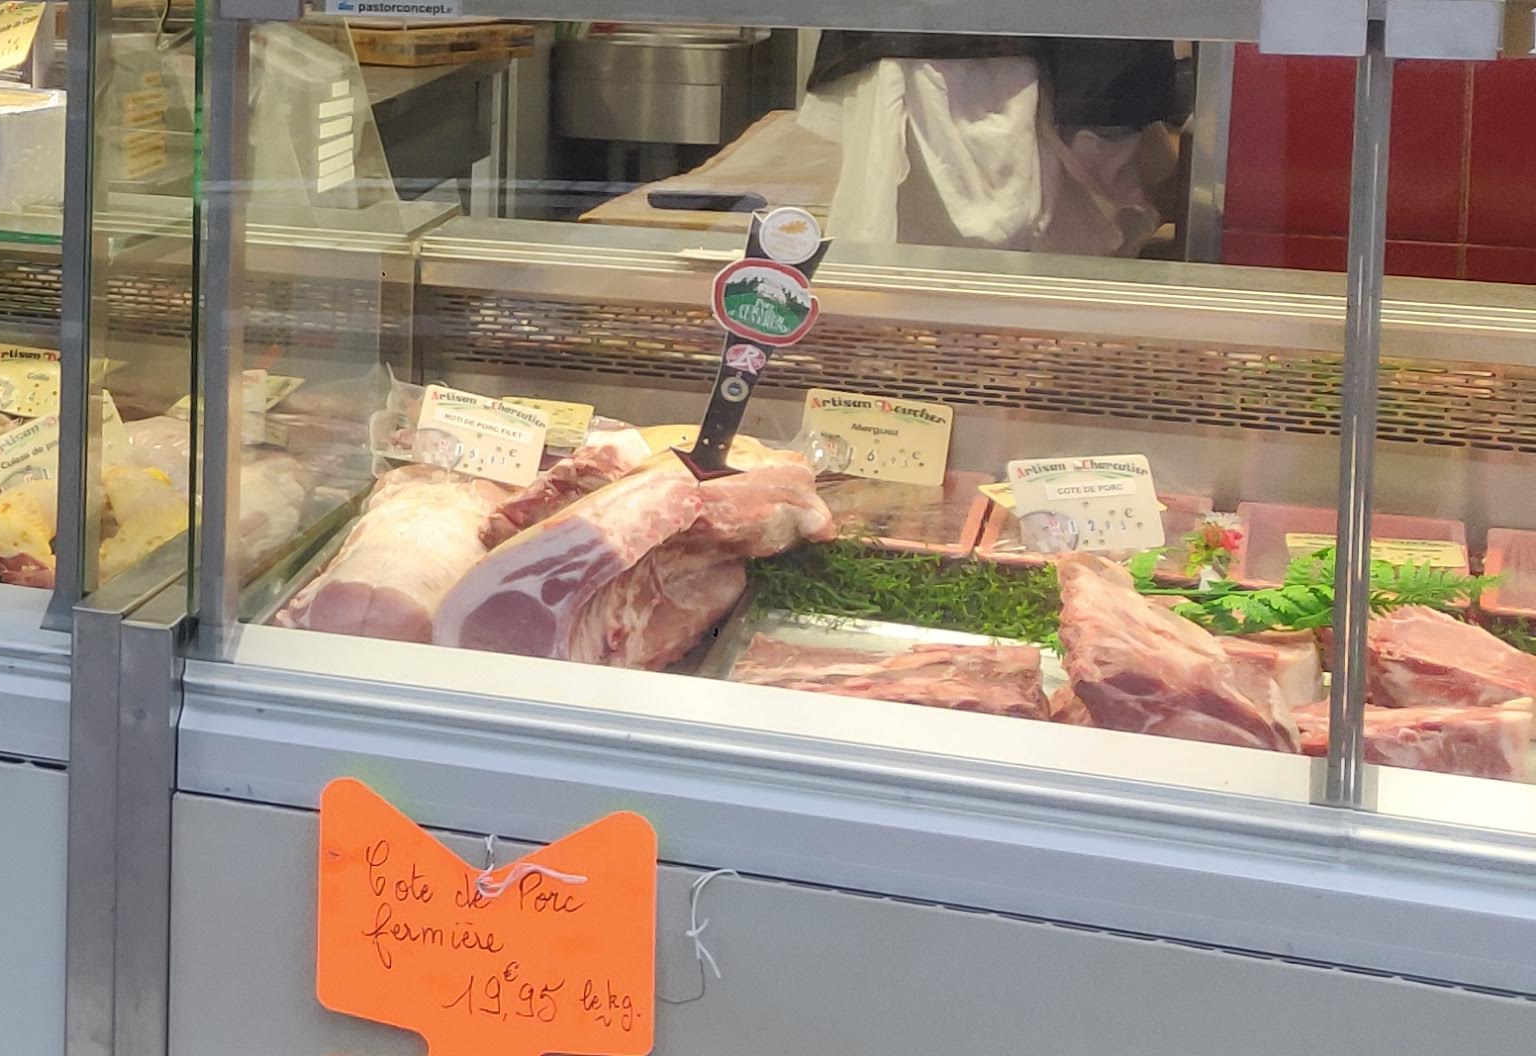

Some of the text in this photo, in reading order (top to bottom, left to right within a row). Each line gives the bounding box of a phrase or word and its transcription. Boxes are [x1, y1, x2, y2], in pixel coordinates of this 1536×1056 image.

[431, 391, 477, 405] Artisan
[810, 395, 872, 409] Artisan
[1016, 462, 1067, 479] Artisan
[455, 870, 492, 910] de
[519, 872, 588, 914] Porc
